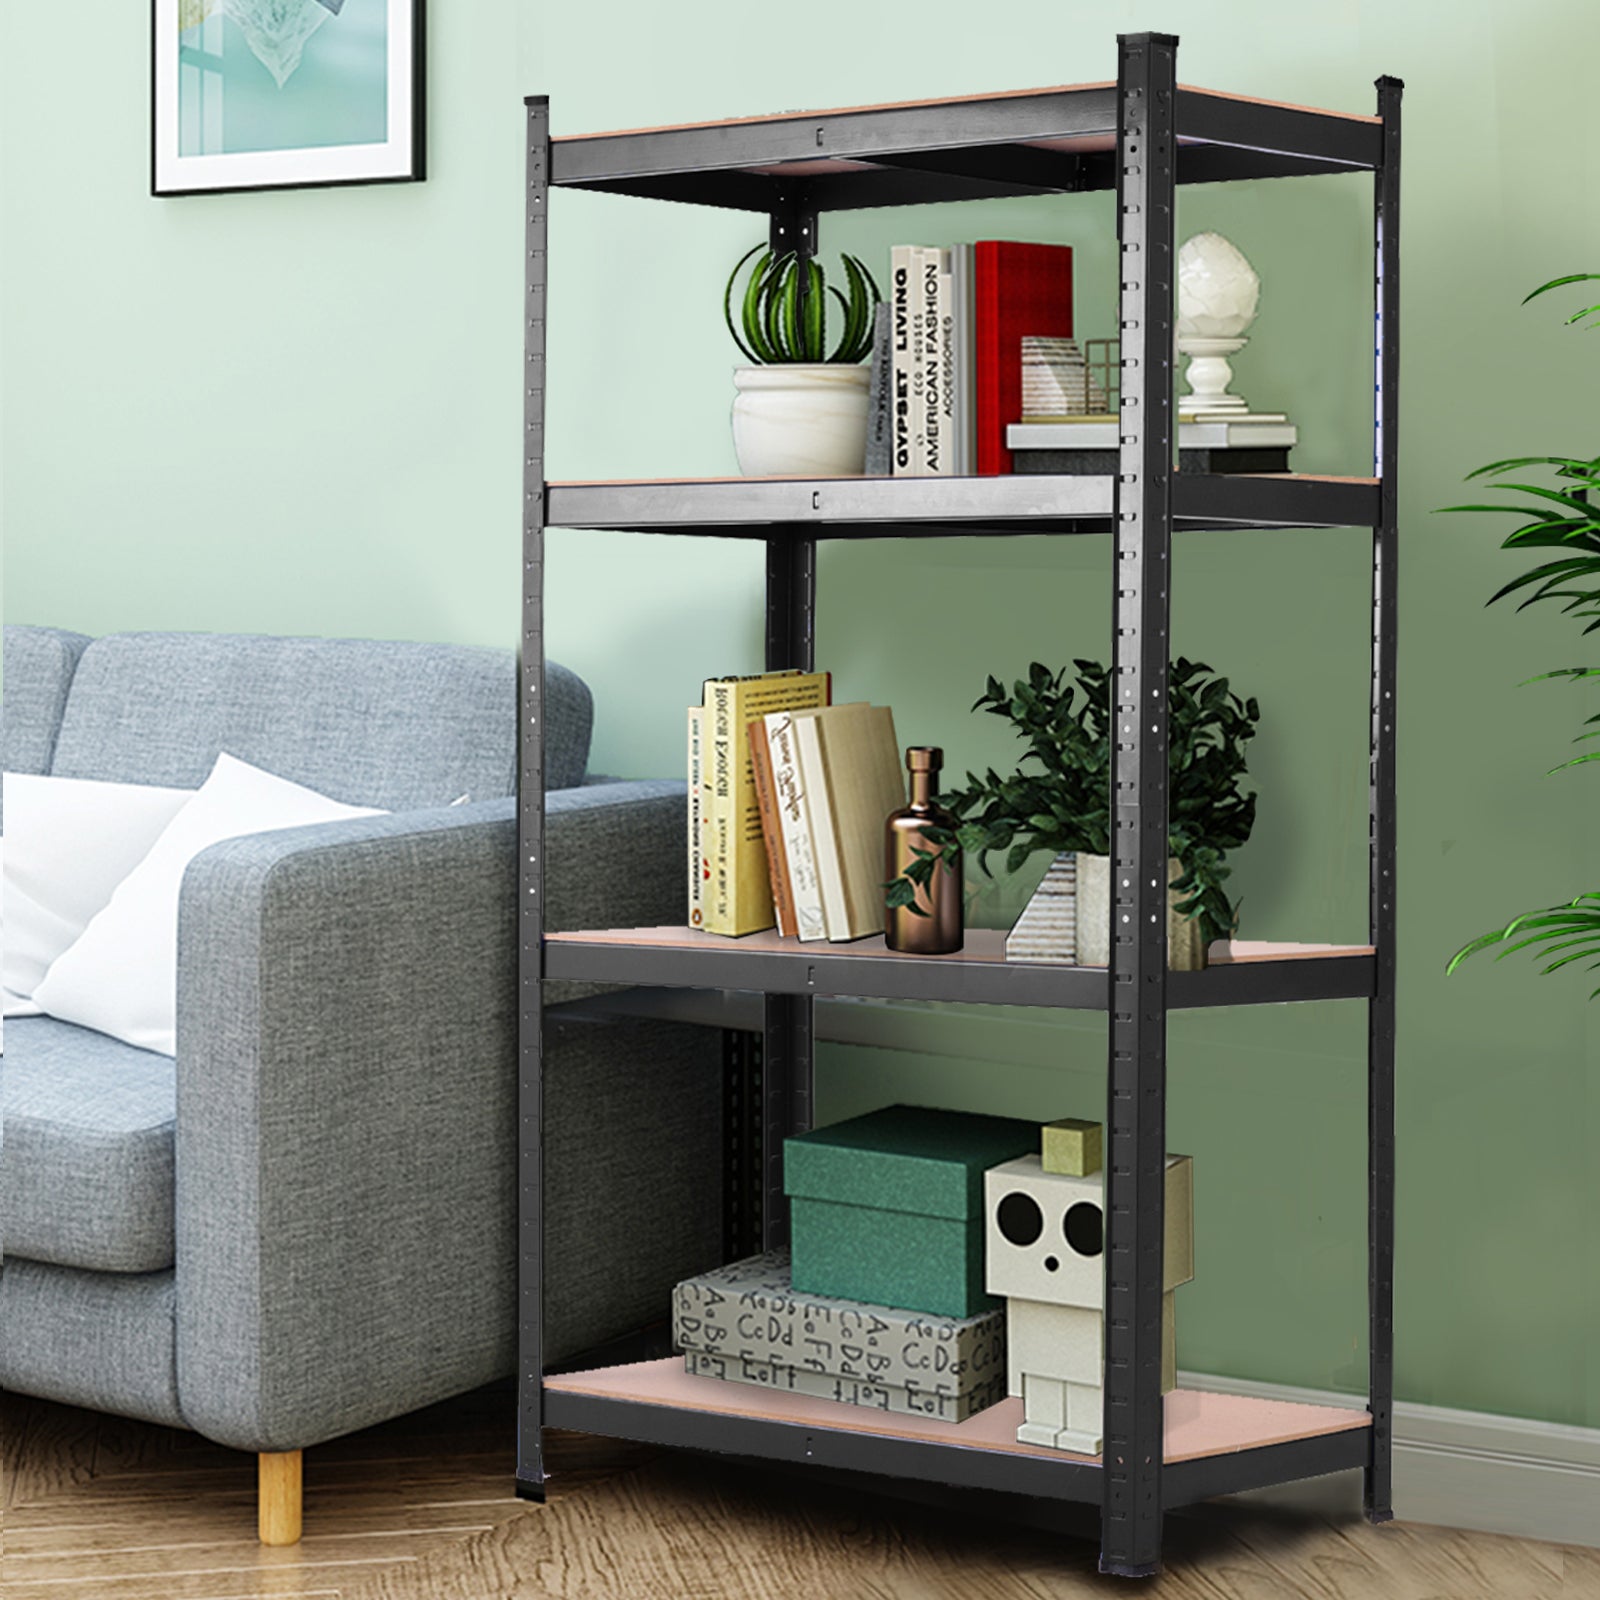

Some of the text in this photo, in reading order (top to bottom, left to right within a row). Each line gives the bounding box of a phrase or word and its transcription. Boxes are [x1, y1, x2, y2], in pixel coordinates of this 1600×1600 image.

[896, 268, 907, 351] LIVING
[925, 264, 939, 471] AMERICAN FASHION
[943, 316, 953, 417] ACCESSORIES
